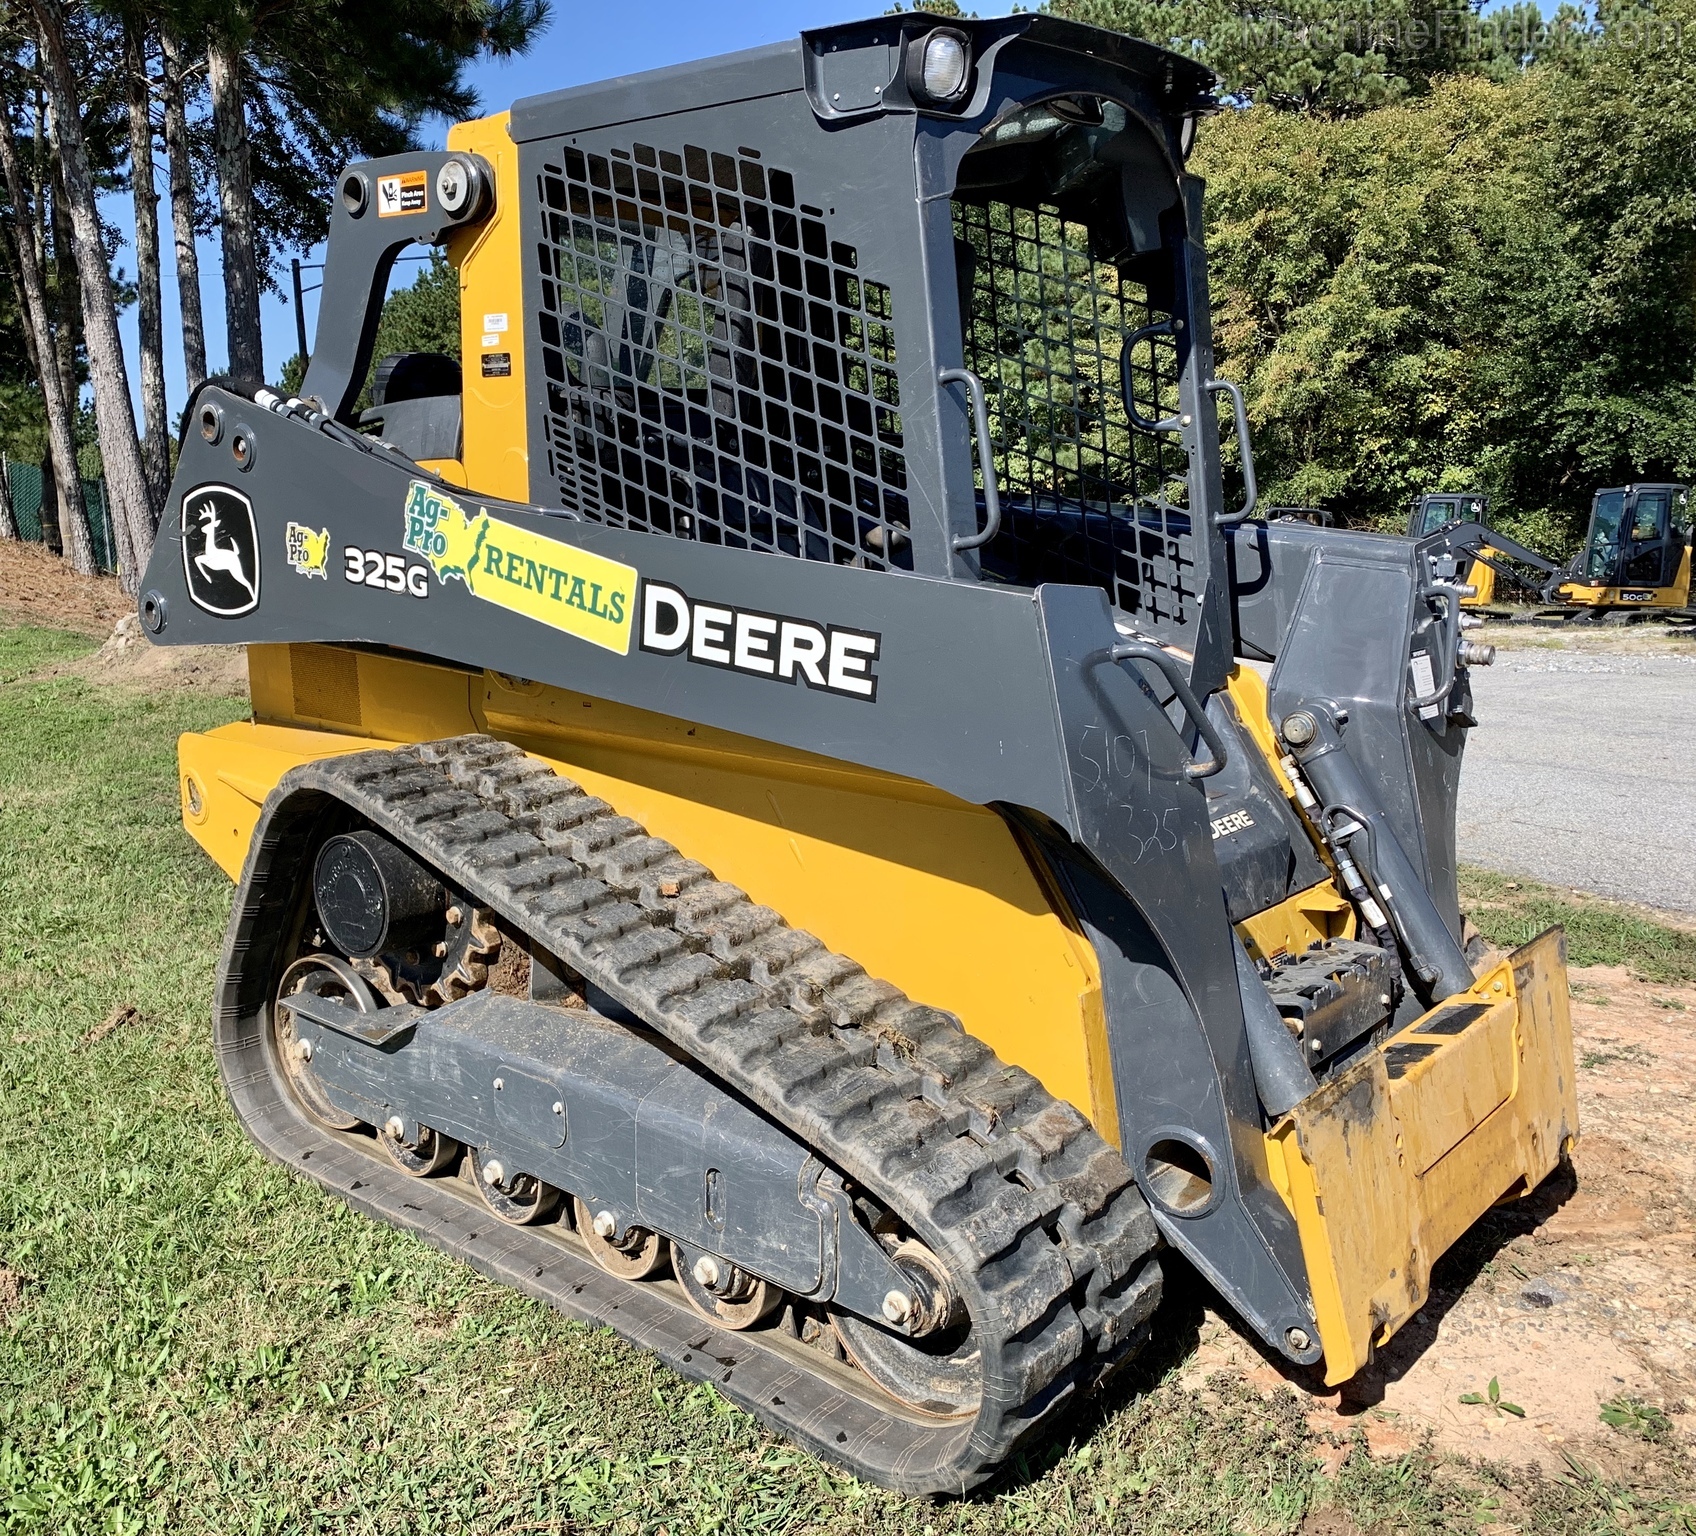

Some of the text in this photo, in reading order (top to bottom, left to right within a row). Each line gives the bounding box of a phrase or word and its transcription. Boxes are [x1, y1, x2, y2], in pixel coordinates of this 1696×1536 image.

[409, 485, 448, 528] Ag-
[290, 543, 309, 562] Pro
[406, 516, 447, 557] Pro
[344, 547, 428, 598] 325G
[483, 543, 625, 625] RENTALS
[643, 583, 876, 696] DEERE
